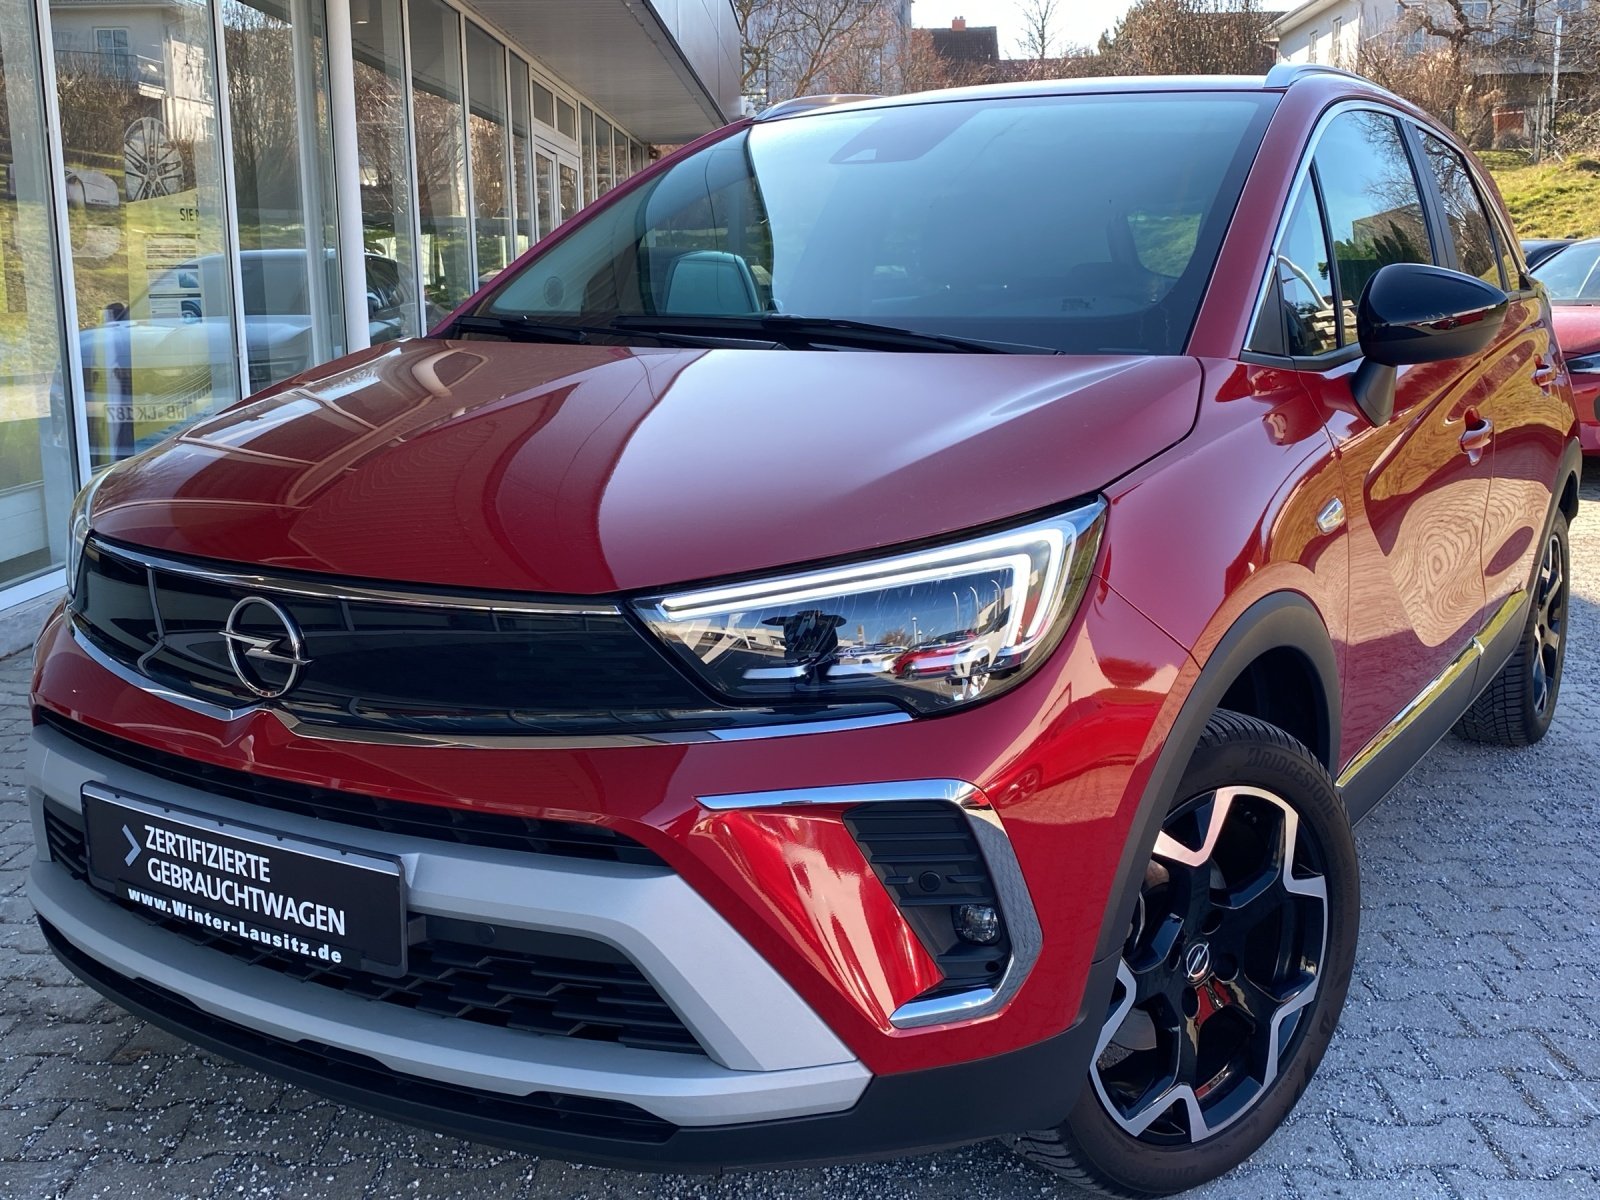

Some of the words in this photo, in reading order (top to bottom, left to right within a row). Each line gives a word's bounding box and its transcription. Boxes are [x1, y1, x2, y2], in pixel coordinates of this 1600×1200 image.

[180, 207, 194, 221] SIE
[1244, 747, 1339, 820] BRIDGESTONE
[144, 824, 271, 883] ZERTIFIZIERTE
[127, 887, 342, 964] www.Winter-Lausitz.de
[147, 858, 346, 936] GEBRAUCHTWAGEN
